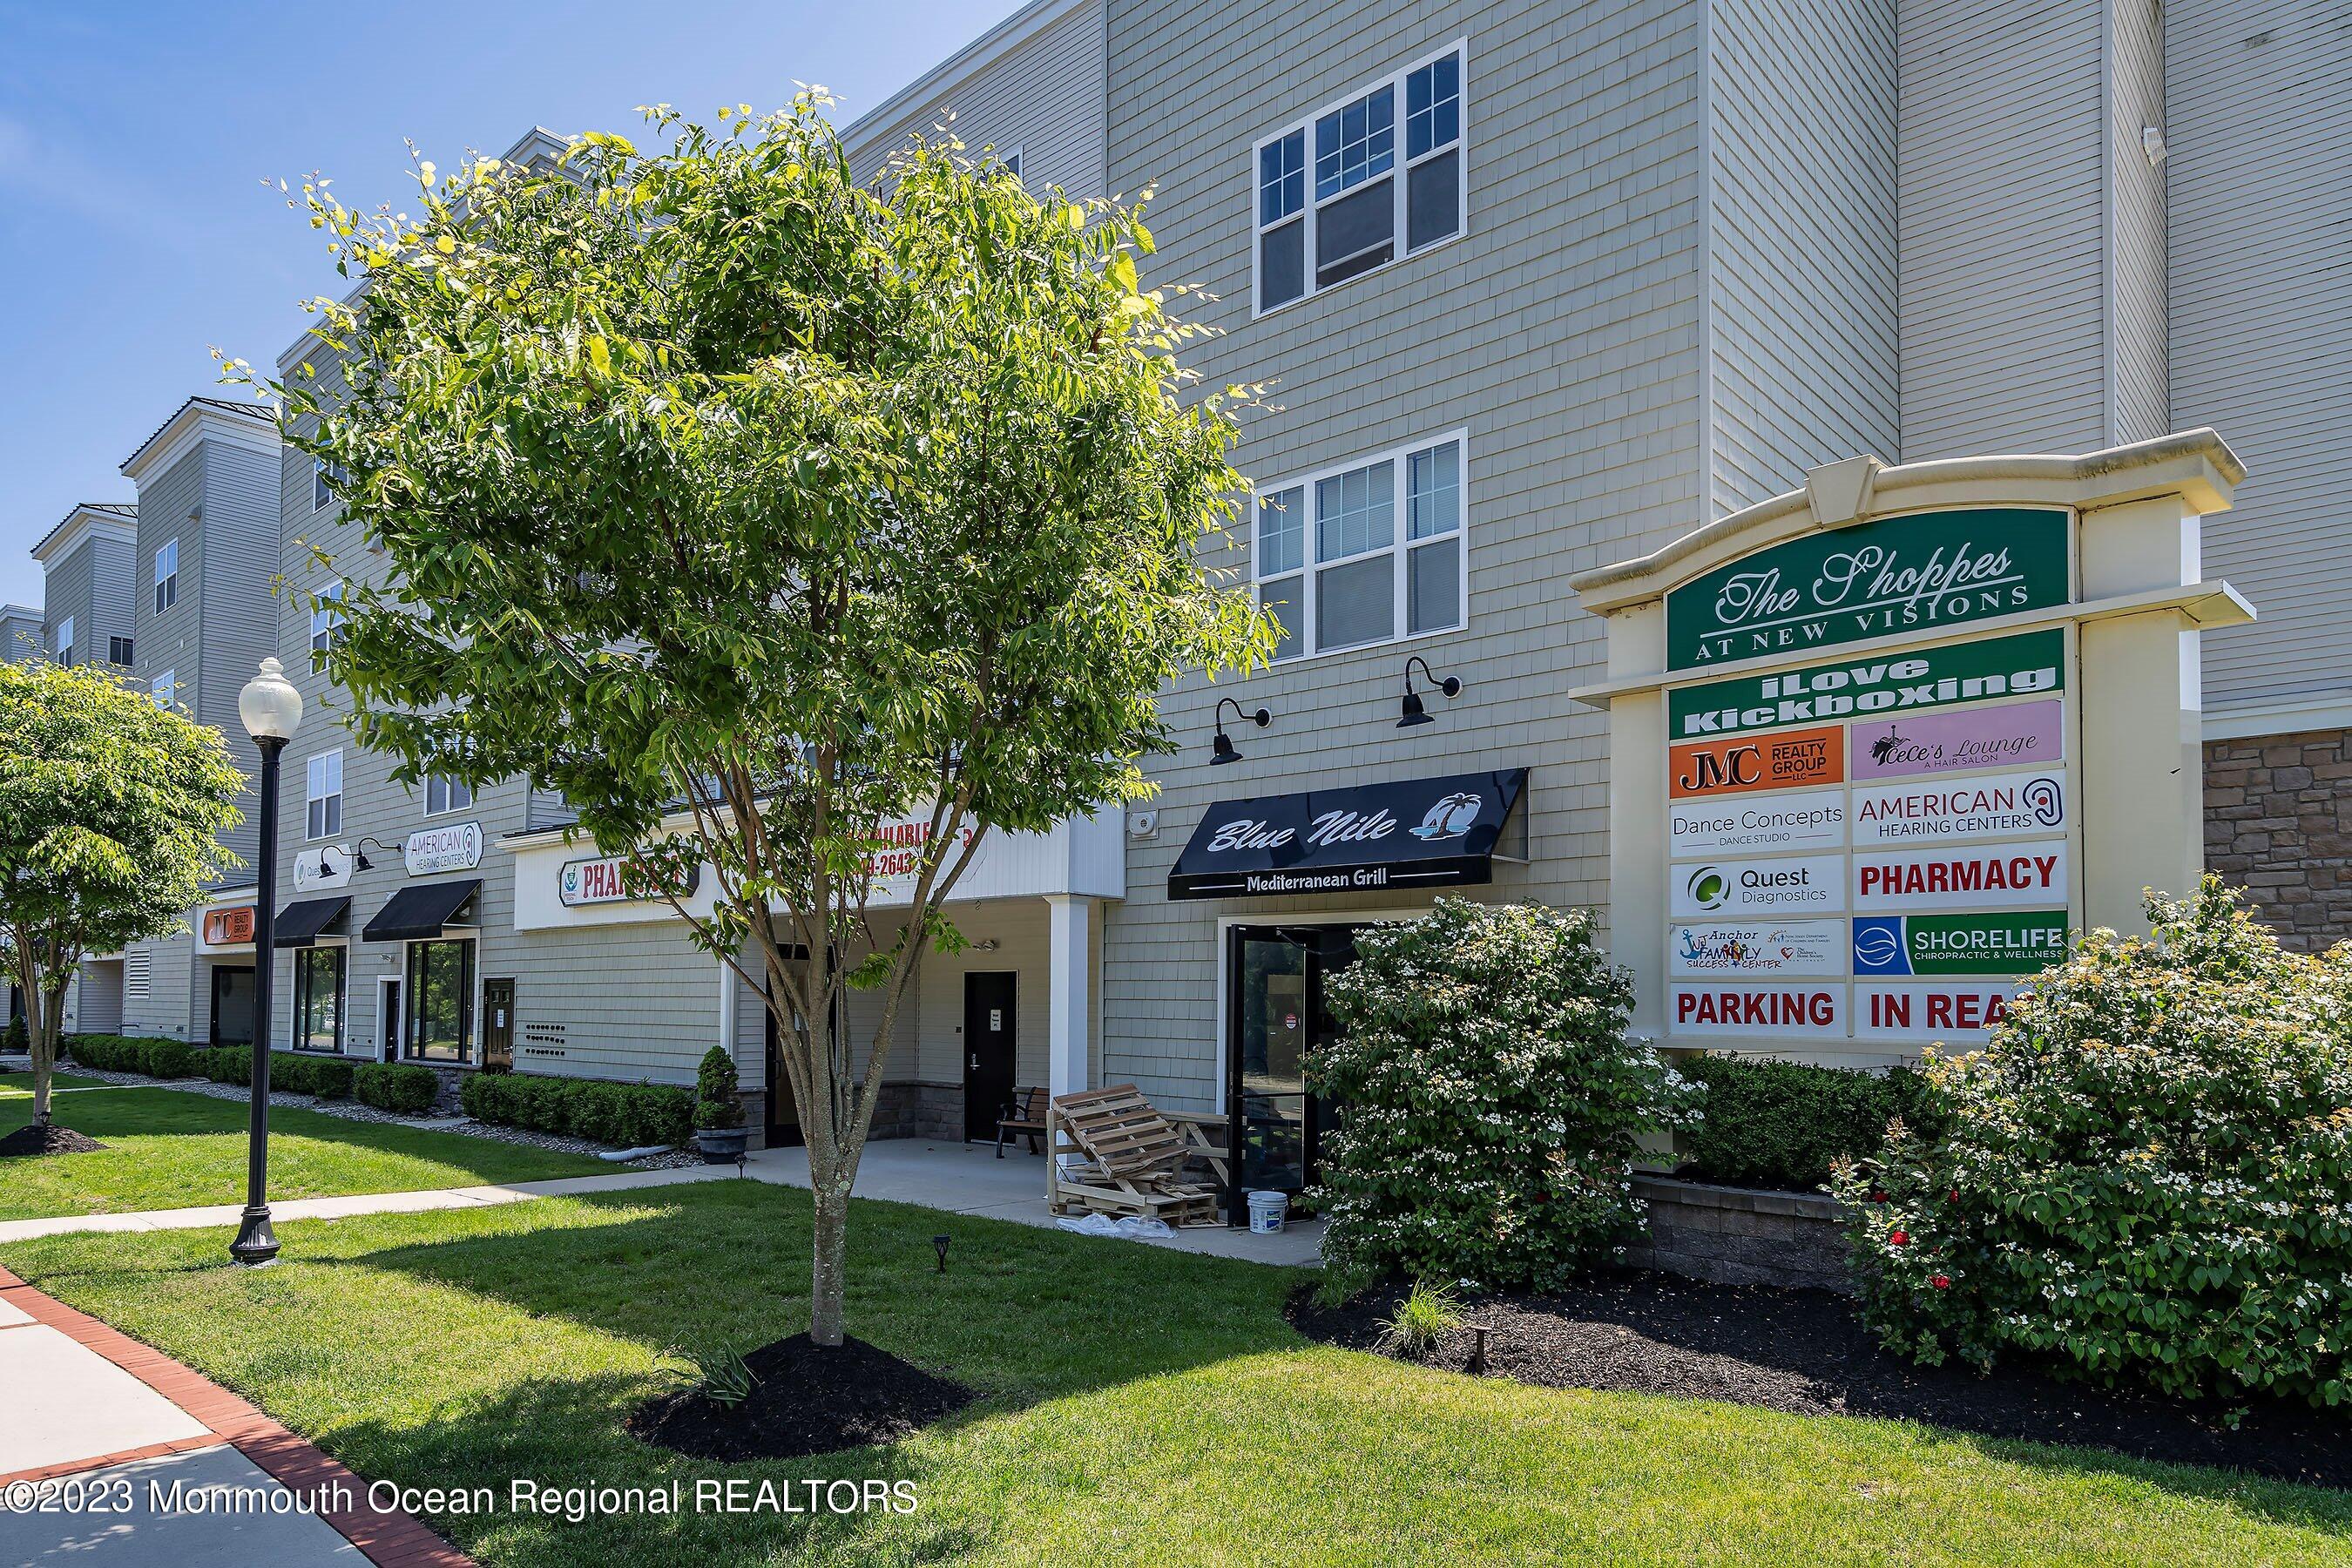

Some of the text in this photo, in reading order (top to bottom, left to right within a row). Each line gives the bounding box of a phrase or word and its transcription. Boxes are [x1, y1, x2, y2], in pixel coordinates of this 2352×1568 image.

[1715, 542, 2011, 624] The Shoppes
[1695, 585, 2029, 660] AT NEW VISIONS
[1761, 659, 1930, 700] iLove
[1685, 667, 2056, 734] Kickboxing
[1772, 742, 1827, 760] REALTY
[1953, 734, 2038, 757] Lounge
[1680, 743, 1761, 791] JMC
[1772, 757, 1827, 774] GROUP
[1935, 759, 1958, 767] HAIR
[1962, 754, 1998, 765] SALON
[1858, 787, 2013, 821] AMERICAN
[1207, 808, 1397, 853] Blue Nile
[1673, 807, 1842, 835] Dance Concepts
[1879, 814, 2032, 837] HEARING CENTERS
[411, 830, 461, 856] AMERICAN
[1720, 833, 1790, 847] DANCE STUDIO
[416, 853, 464, 870] HEARING CENTERS
[1247, 868, 1388, 893] Mediterranean Grill
[1740, 868, 1809, 888] Quest
[1861, 855, 2058, 896] PHARMACY
[1742, 889, 1827, 904] Diagnostics
[1709, 930, 1758, 940] Anchor
[1915, 928, 2062, 950] SHORELIFE
[1686, 959, 1781, 969] SUCCESS CENTER
[1915, 951, 1990, 960] CHIROPRACTIC
[2004, 950, 2063, 959] WELLNESS
[1678, 992, 2037, 1028] PARKING IN REA
